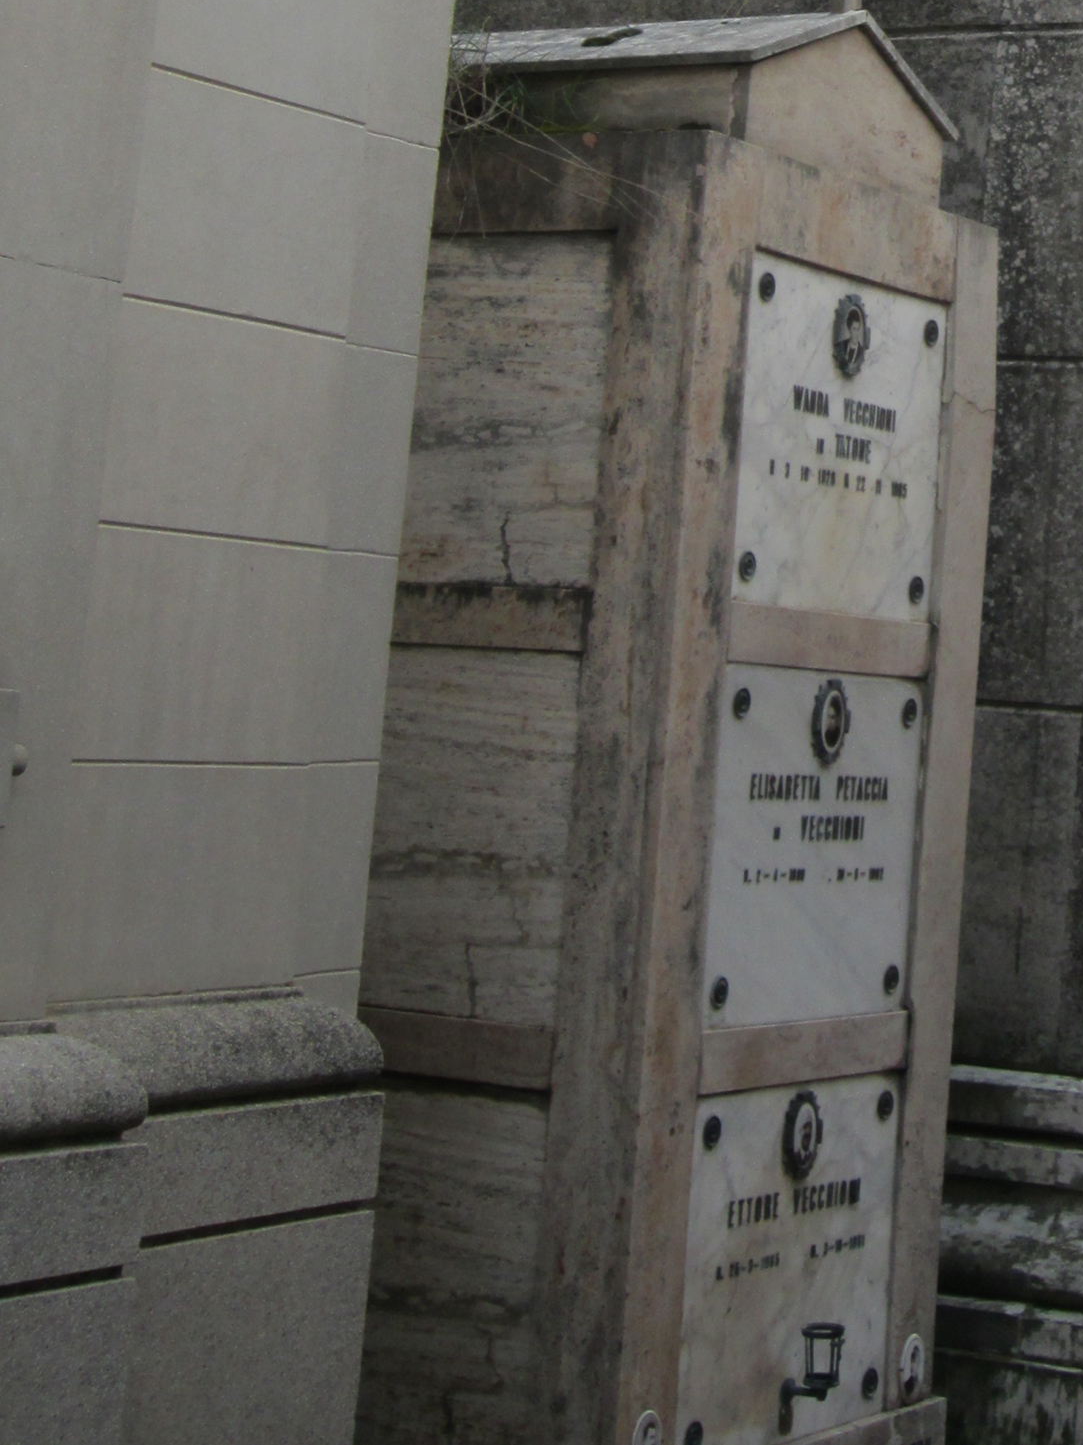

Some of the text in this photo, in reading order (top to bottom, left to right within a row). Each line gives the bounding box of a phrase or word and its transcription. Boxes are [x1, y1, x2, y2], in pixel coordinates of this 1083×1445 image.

[793, 385, 896, 433] WANDA VECCHIONI
[835, 433, 871, 464] TATONE
[750, 774, 820, 802] ELISABETTA
[800, 815, 864, 842] VECCHIONI
[727, 1178, 861, 1229] ETTORE VECCHIONI
